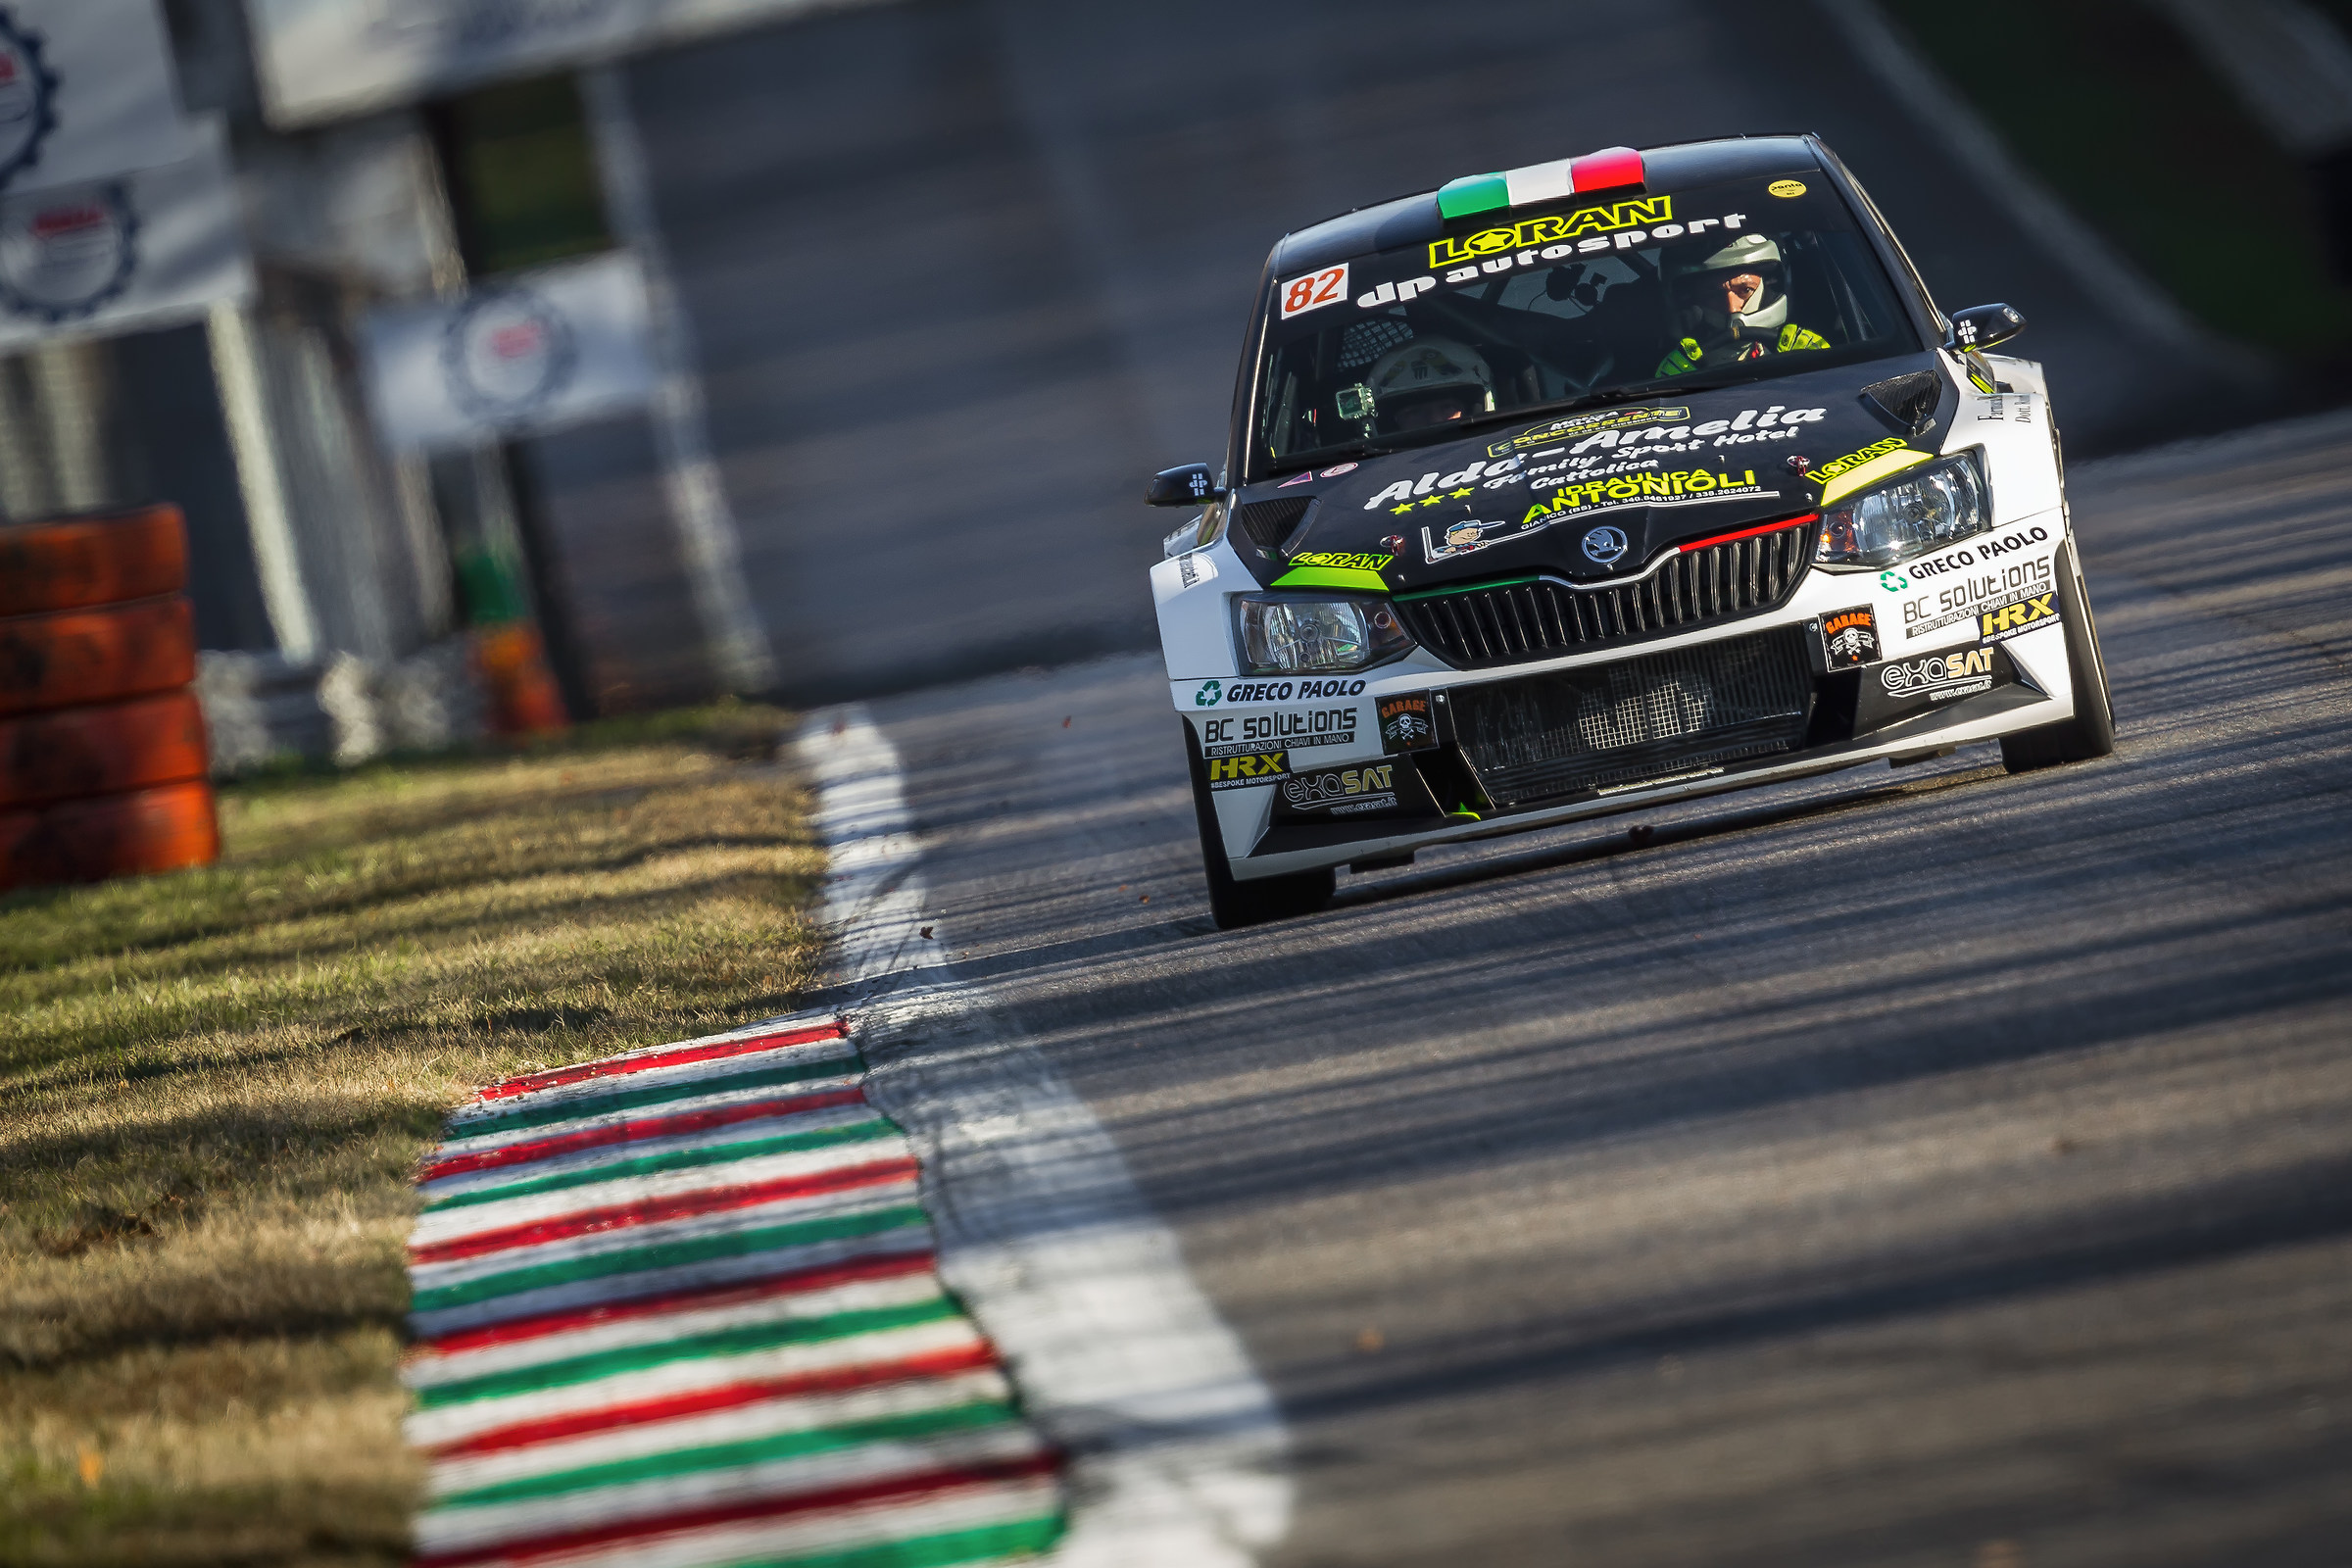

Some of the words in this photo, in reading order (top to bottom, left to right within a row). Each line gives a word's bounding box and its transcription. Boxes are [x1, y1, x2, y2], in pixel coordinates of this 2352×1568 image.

[1429, 196, 1673, 269] LORAN
[1356, 275, 1437, 309] dp
[1446, 213, 1747, 283] autosport
[1284, 269, 1346, 314] 82
[1483, 455, 1603, 489] Family
[1612, 439, 1704, 460] Sport
[1714, 426, 1799, 447] Hotel
[1804, 437, 1908, 485] LORAN
[1530, 459, 1659, 490] Cattolica
[1557, 468, 1711, 497] IDRAULICA
[1522, 469, 1756, 524] ANTONIOLI
[1288, 552, 1394, 571] LORAN
[1908, 551, 1975, 580] GRECO
[1977, 526, 2048, 560] PAOLO
[1826, 612, 1873, 634] GARAGE
[1903, 595, 1932, 624] BC
[1912, 605, 1979, 636] RISTRUTTURAZIONI
[1981, 596, 2008, 612] CHIAVI
[2009, 592, 2019, 602] IN
[2020, 582, 2047, 599] MANO
[1983, 592, 2055, 636] HRX
[1227, 681, 1294, 703] GRECO
[1297, 679, 1367, 700] PAOLO
[1382, 699, 1427, 718] GARAGE
[1204, 717, 1235, 744] BC
[1210, 740, 1282, 757] RISTRUTTURAZIONI
[1284, 736, 1311, 748] CHIAVI
[1313, 736, 1322, 745] IN
[1323, 732, 1349, 744] MANO
[1210, 753, 1285, 781] HRX
[1246, 772, 1291, 784] MOTORSPORT
